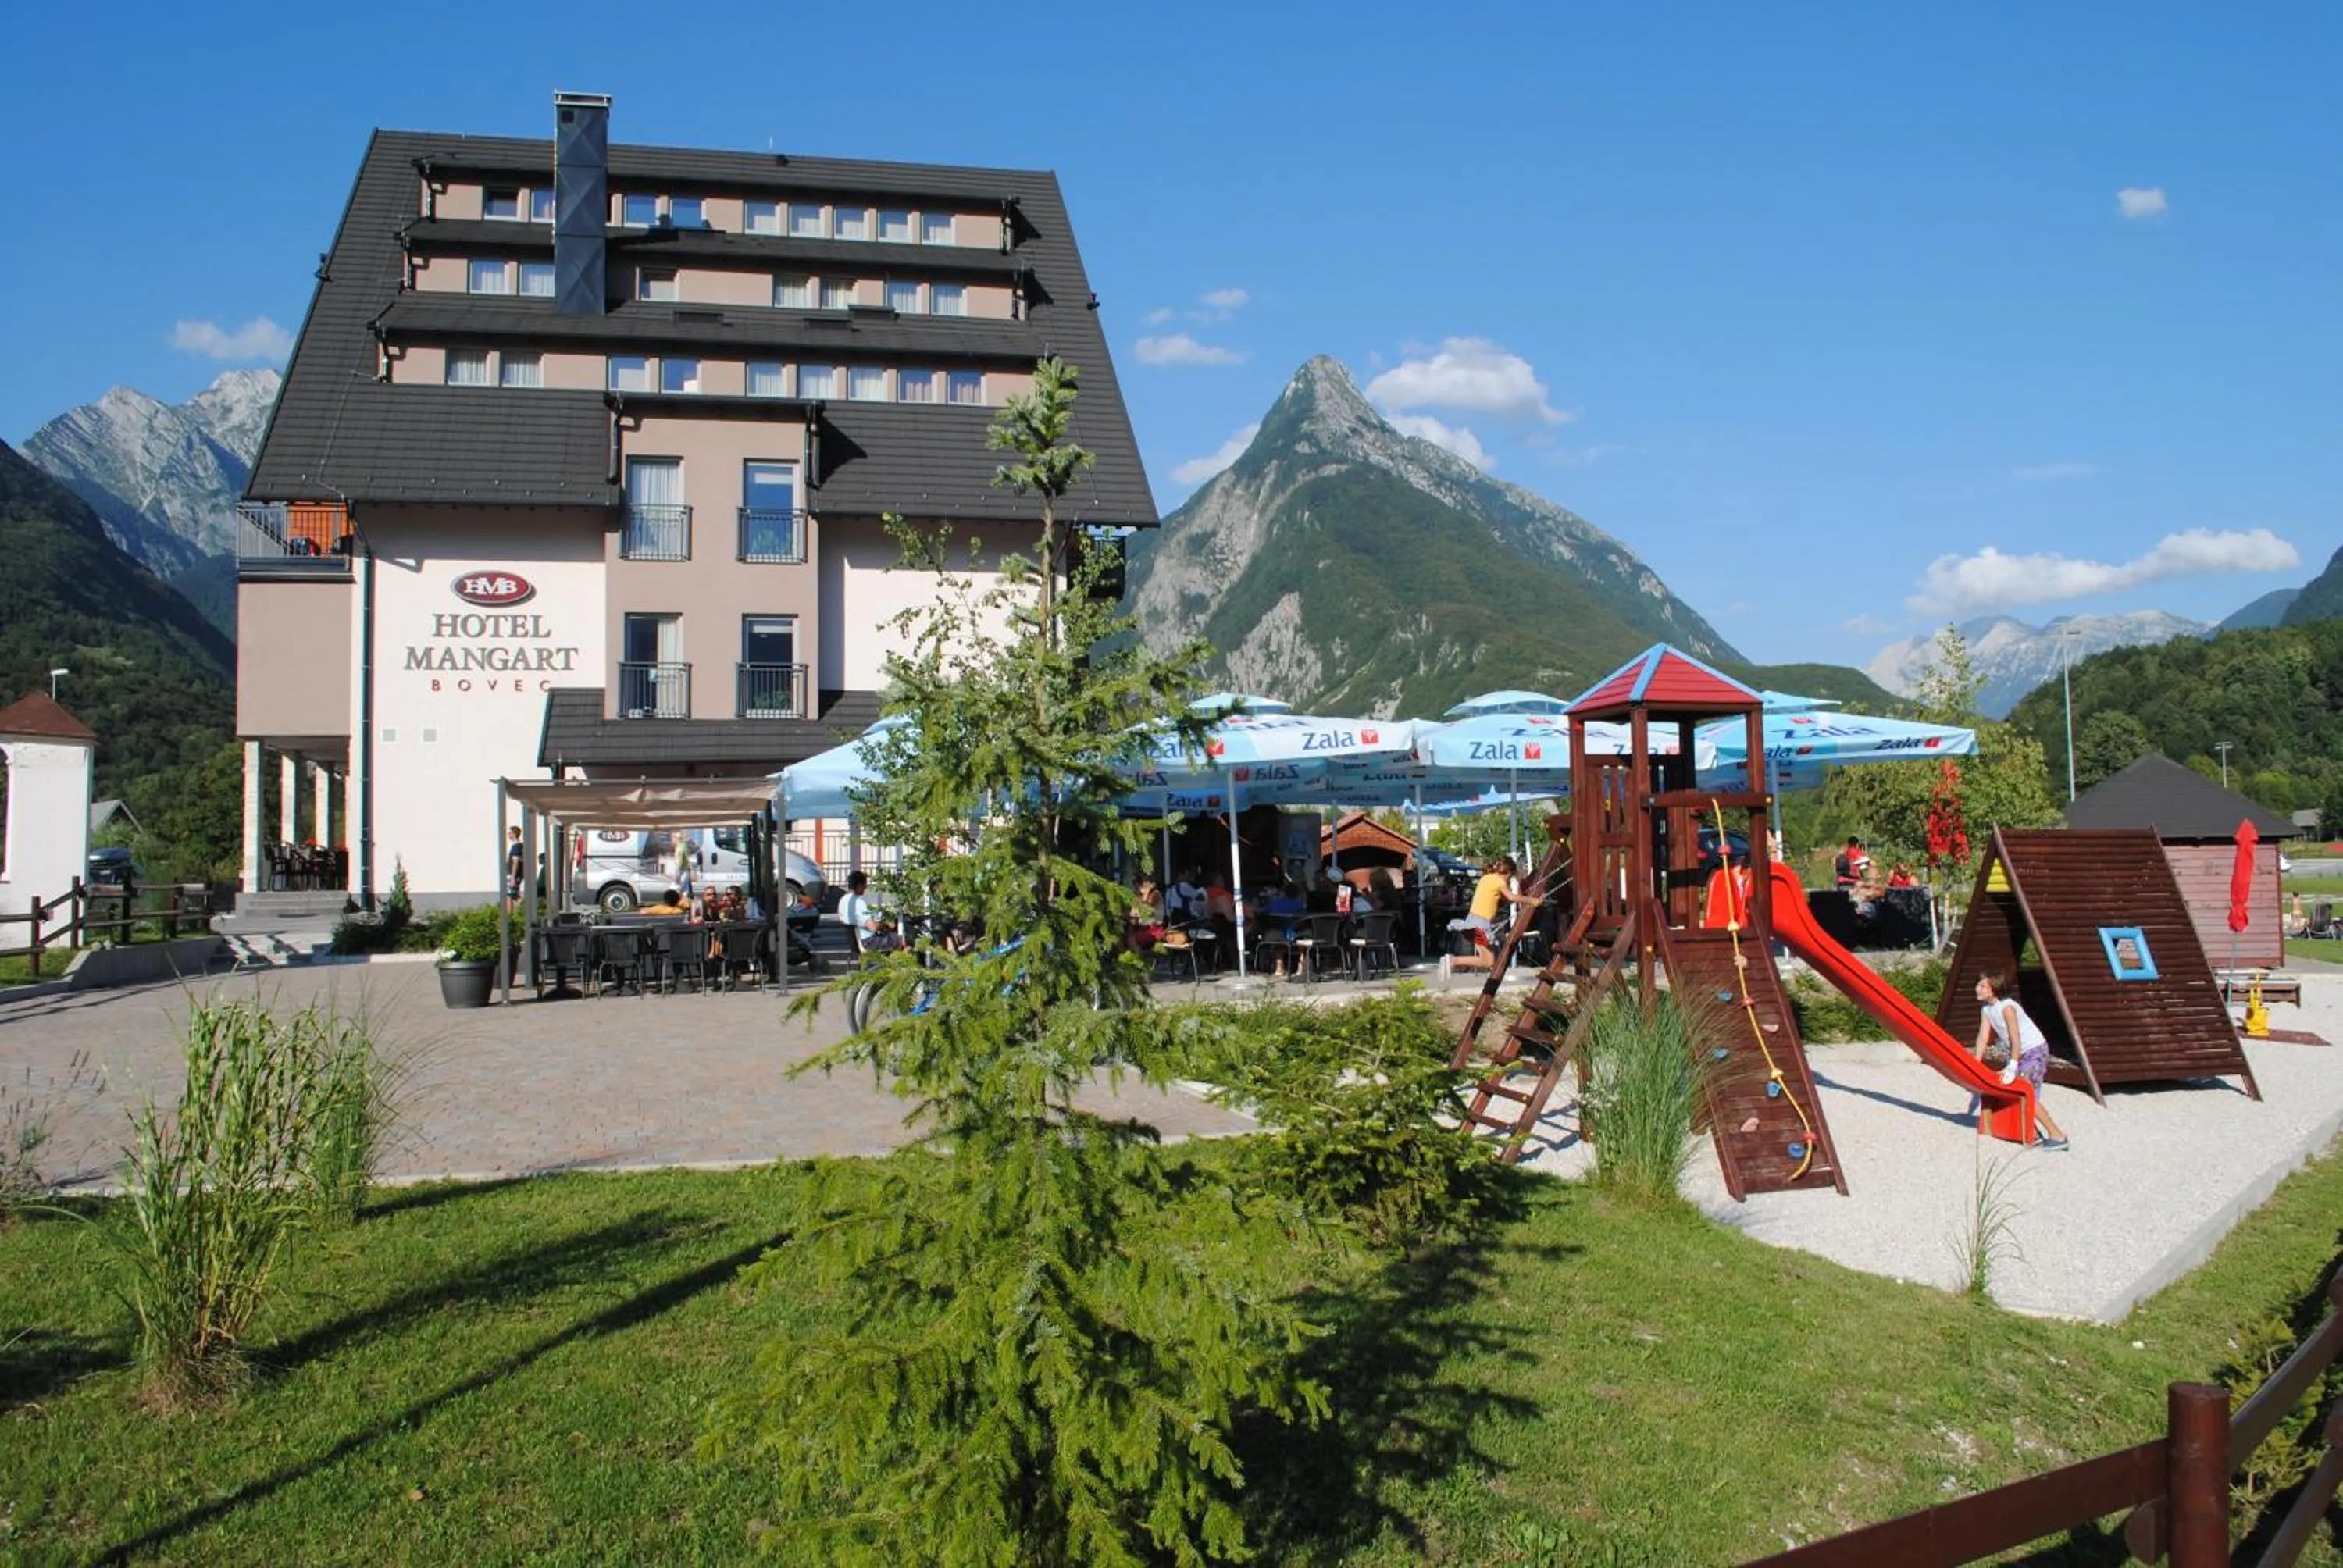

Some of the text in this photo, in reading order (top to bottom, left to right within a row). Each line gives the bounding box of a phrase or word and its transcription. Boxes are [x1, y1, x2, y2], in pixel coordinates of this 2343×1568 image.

[433, 613, 551, 638] HOTEL
[403, 646, 579, 672] MANGART
[431, 679, 551, 692] BOVEC
[1302, 730, 1356, 751] Zala
[1469, 740, 1519, 761] Zala
[1762, 744, 1792, 758] ala
